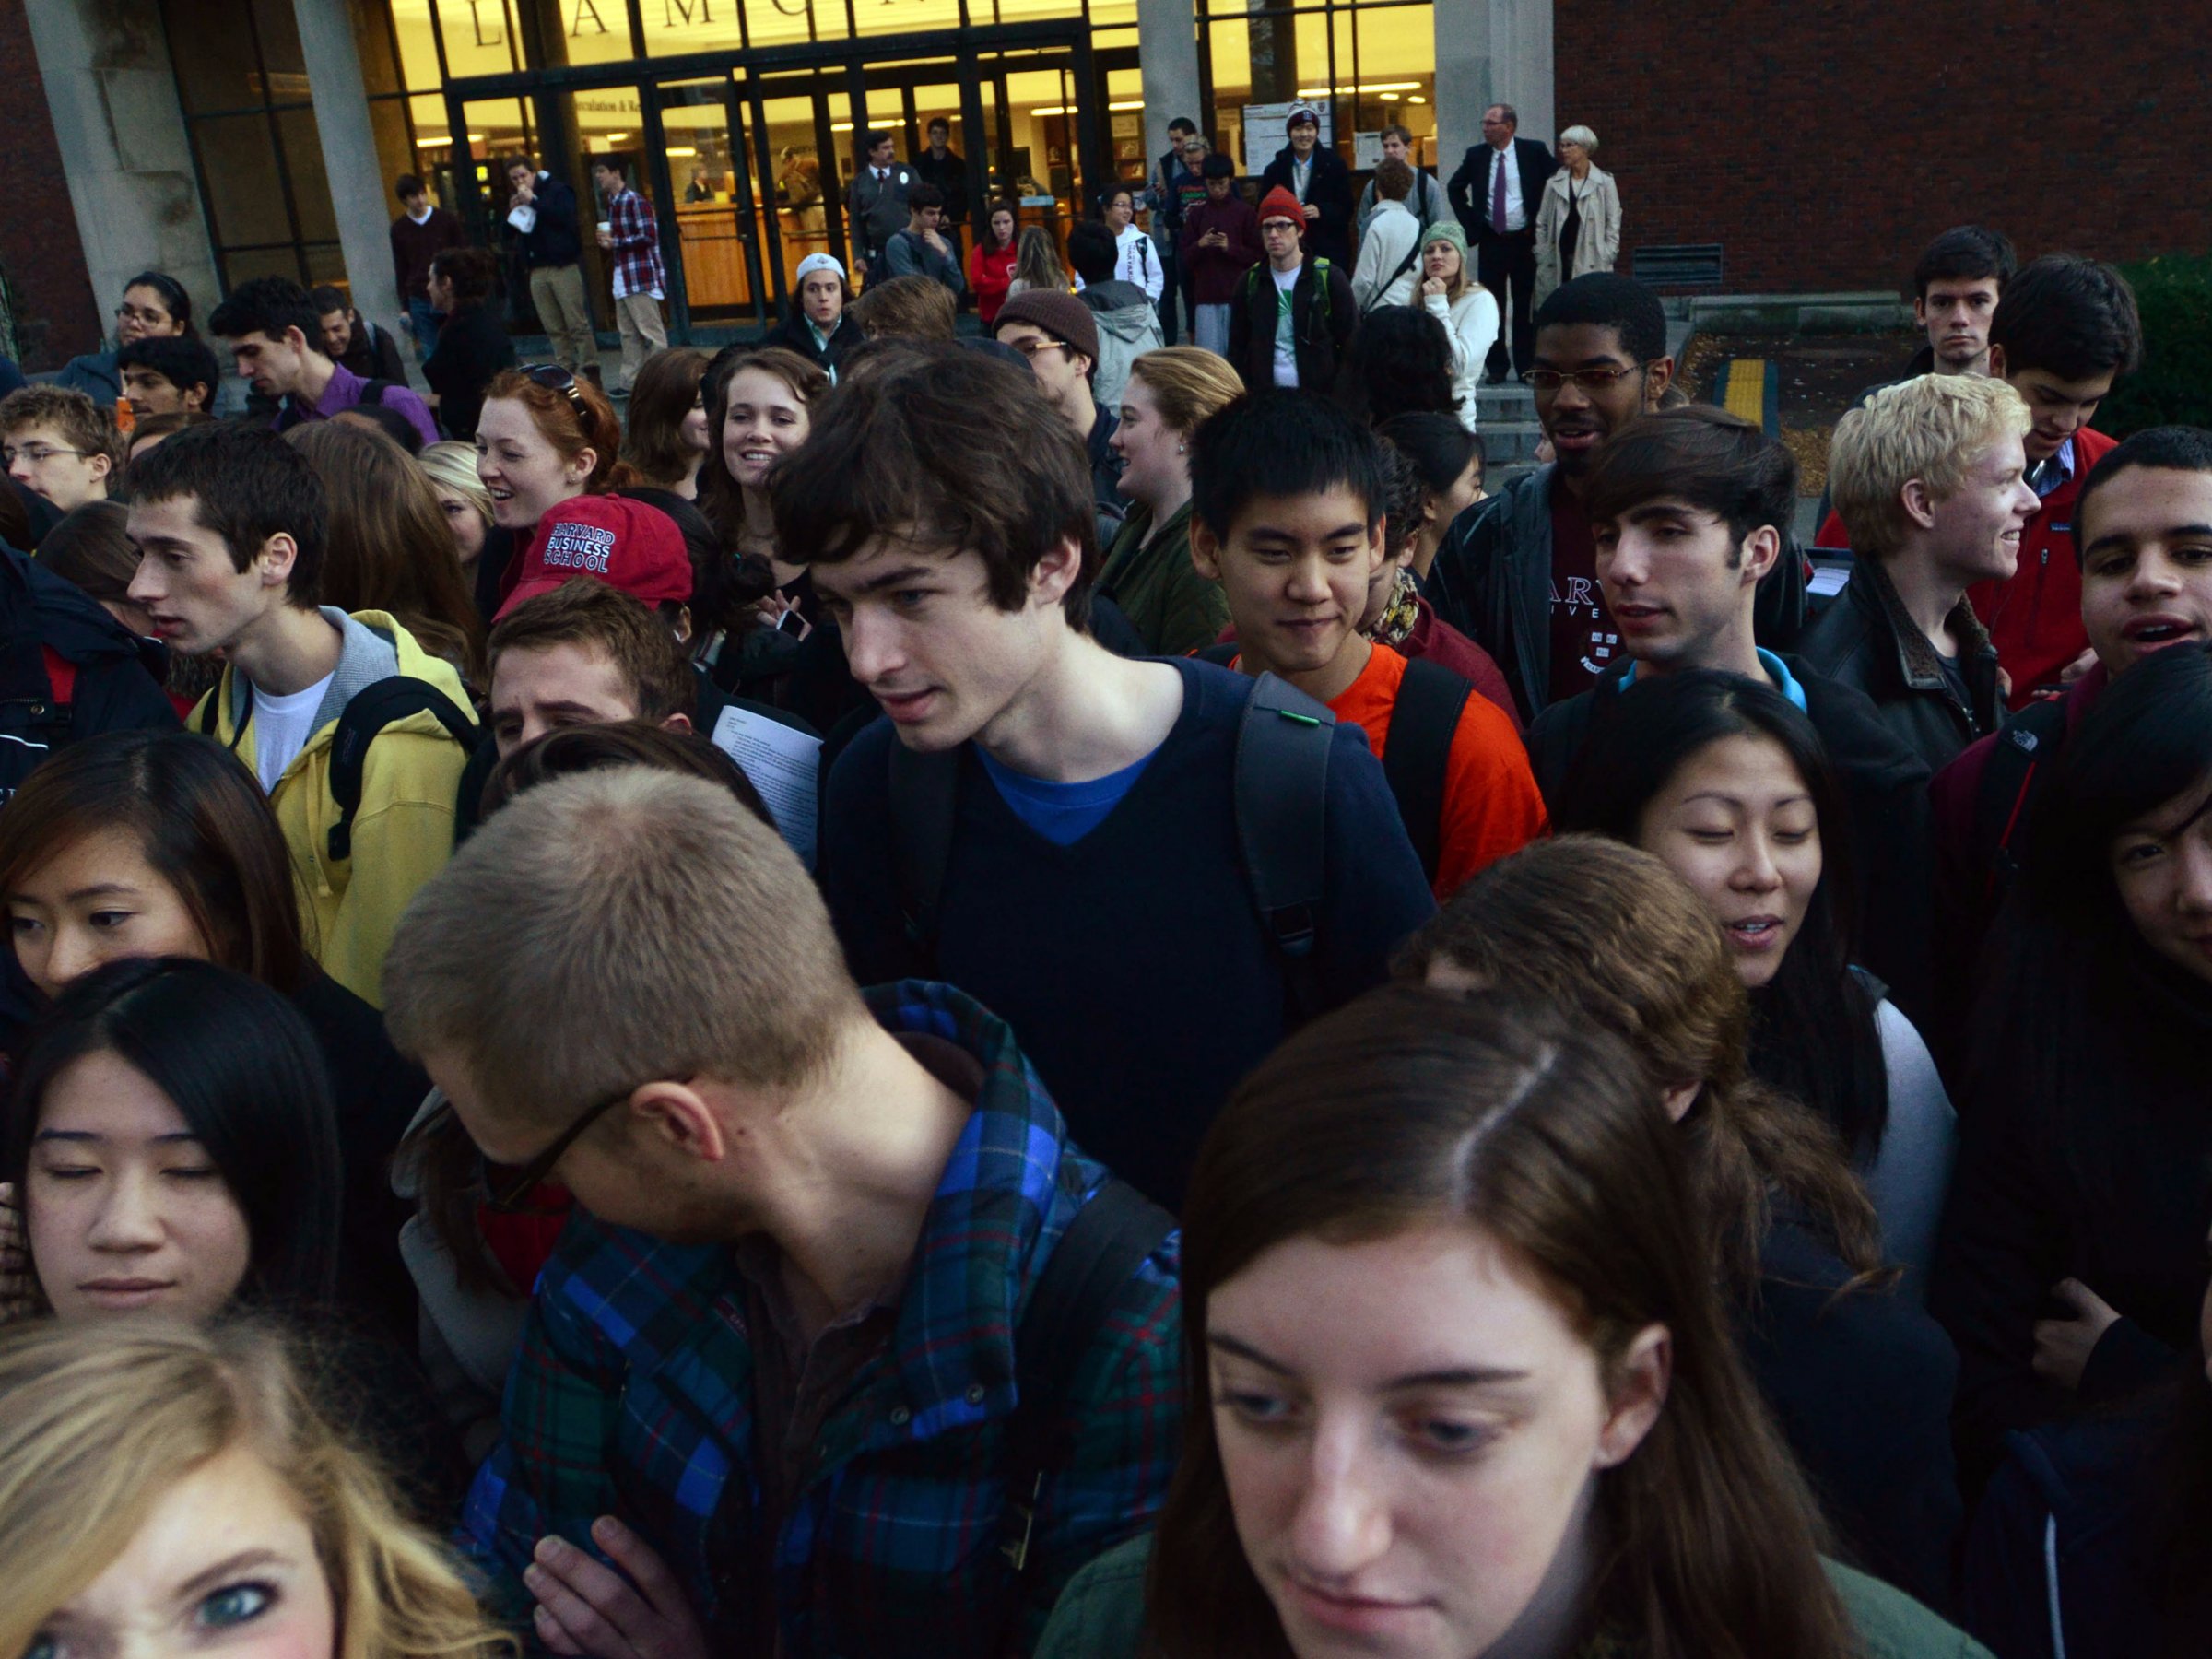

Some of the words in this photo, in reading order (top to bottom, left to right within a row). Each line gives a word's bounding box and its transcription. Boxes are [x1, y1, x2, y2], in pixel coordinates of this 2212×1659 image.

[551, 523, 615, 545] HARVARD
[547, 537, 610, 559] BUSINESS
[544, 549, 608, 573] SCHOOL
